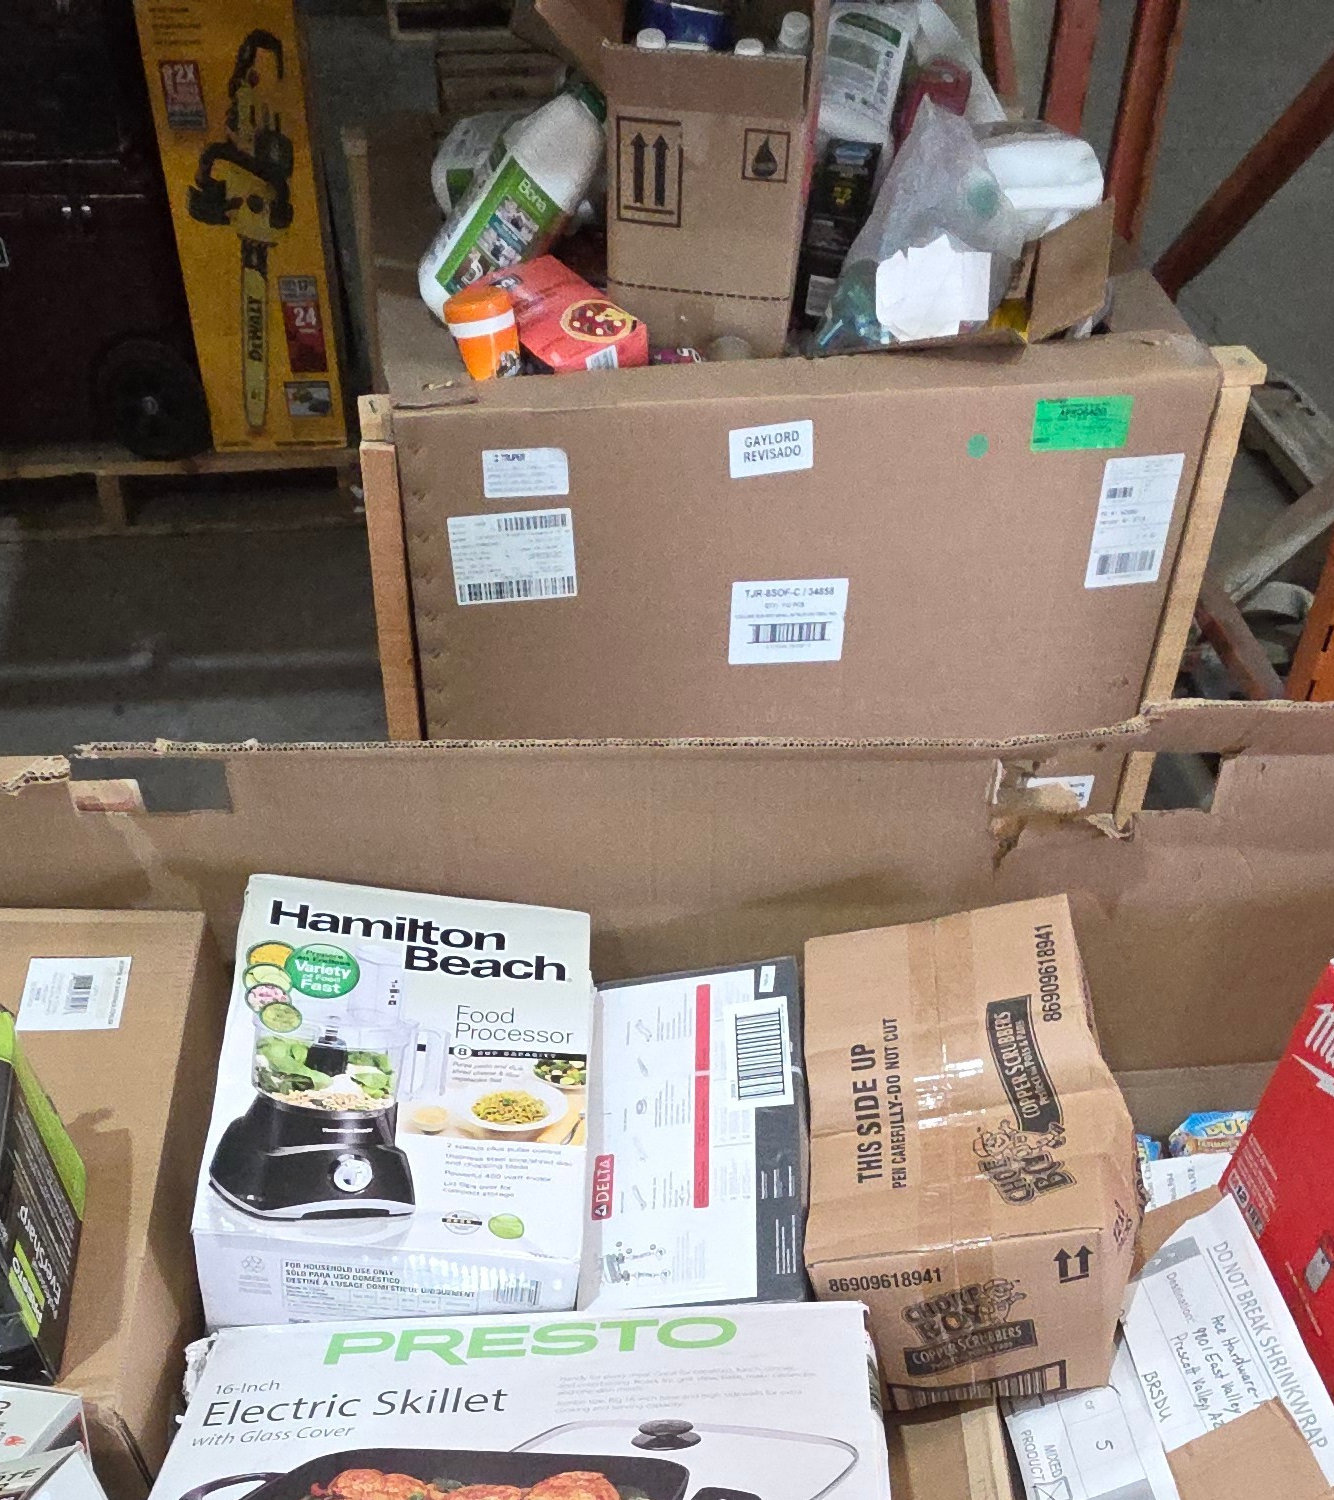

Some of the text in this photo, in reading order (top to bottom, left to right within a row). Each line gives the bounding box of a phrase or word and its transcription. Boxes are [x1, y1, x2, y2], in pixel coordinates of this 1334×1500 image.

[518, 178, 547, 212] Bona
[744, 445, 801, 463] REVISADO
[745, 430, 800, 448] GAYLORD
[269, 899, 507, 952] Hamilton
[295, 960, 352, 979] Variety
[403, 944, 568, 983] Beach
[1035, 923, 1063, 1022] 86909618941
[301, 979, 341, 993] Fast
[456, 1004, 515, 1024] Food
[455, 1022, 573, 1044] Processor
[883, 1018, 899, 1070] NOT CUT
[851, 1043, 883, 1184] THIS SIDE UP
[596, 1158, 613, 1204] DELTA
[828, 1267, 942, 1293] 86909618941
[1211, 1314, 1227, 1336] Ace
[323, 1315, 738, 1367] PRESTO
[1213, 1241, 1329, 1450] DO NOT BREAK SHRINKWRAP
[1205, 1353, 1225, 1380] East
[214, 1378, 281, 1397] 16-Inch
[202, 1387, 509, 1429] Electric Skillet
[192, 1424, 355, 1449] with Glass Cover
[1095, 1439, 1113, 1451] 5
[1021, 1429, 1046, 1481] PRODUCT
[1043, 1444, 1062, 1478] MIXED
